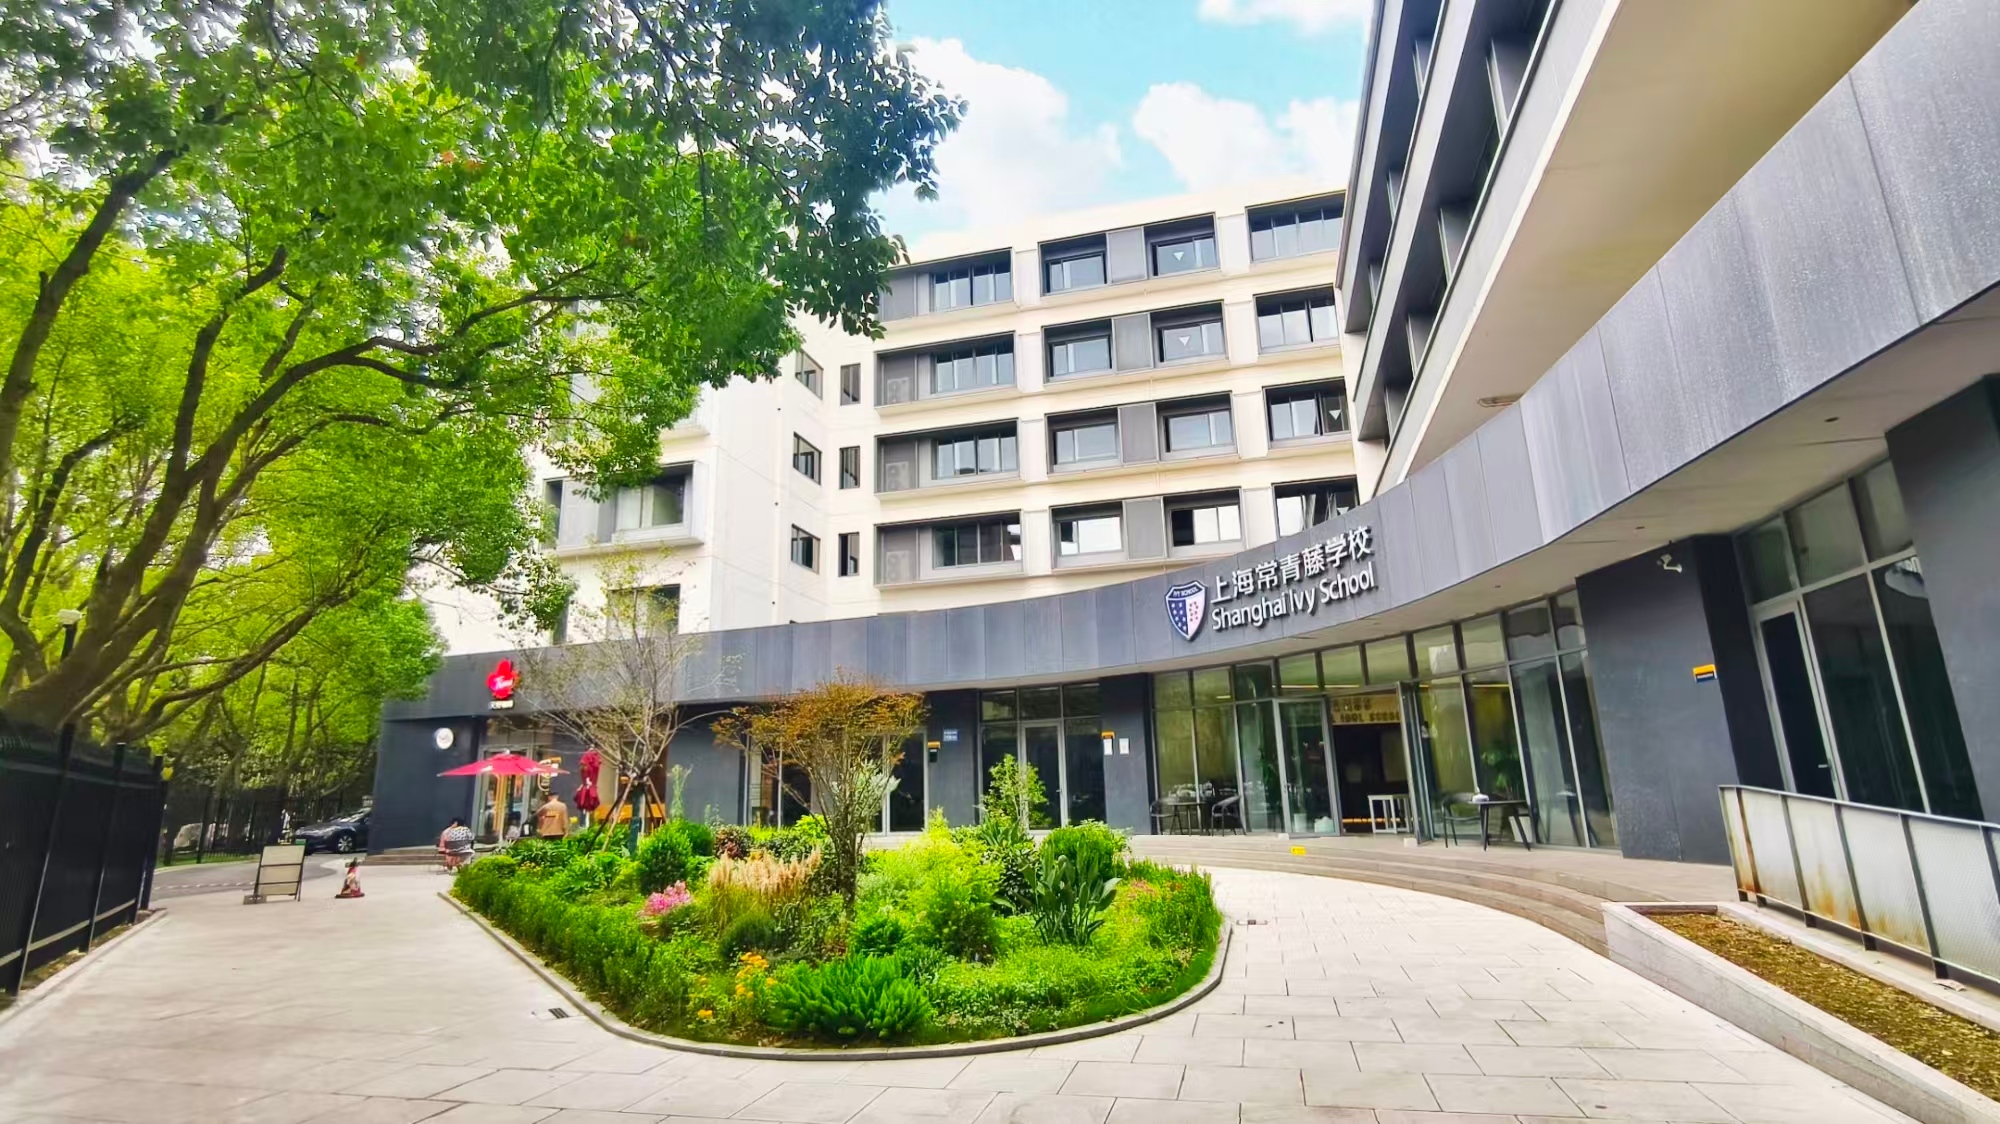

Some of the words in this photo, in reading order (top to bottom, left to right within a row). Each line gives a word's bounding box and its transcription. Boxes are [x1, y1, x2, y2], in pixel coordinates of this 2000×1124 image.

[1210, 525, 1372, 604] 上海常青藤学校
[1212, 591, 1287, 630] Shanghai
[1289, 588, 1316, 615] Ivy
[1319, 562, 1375, 604] School
